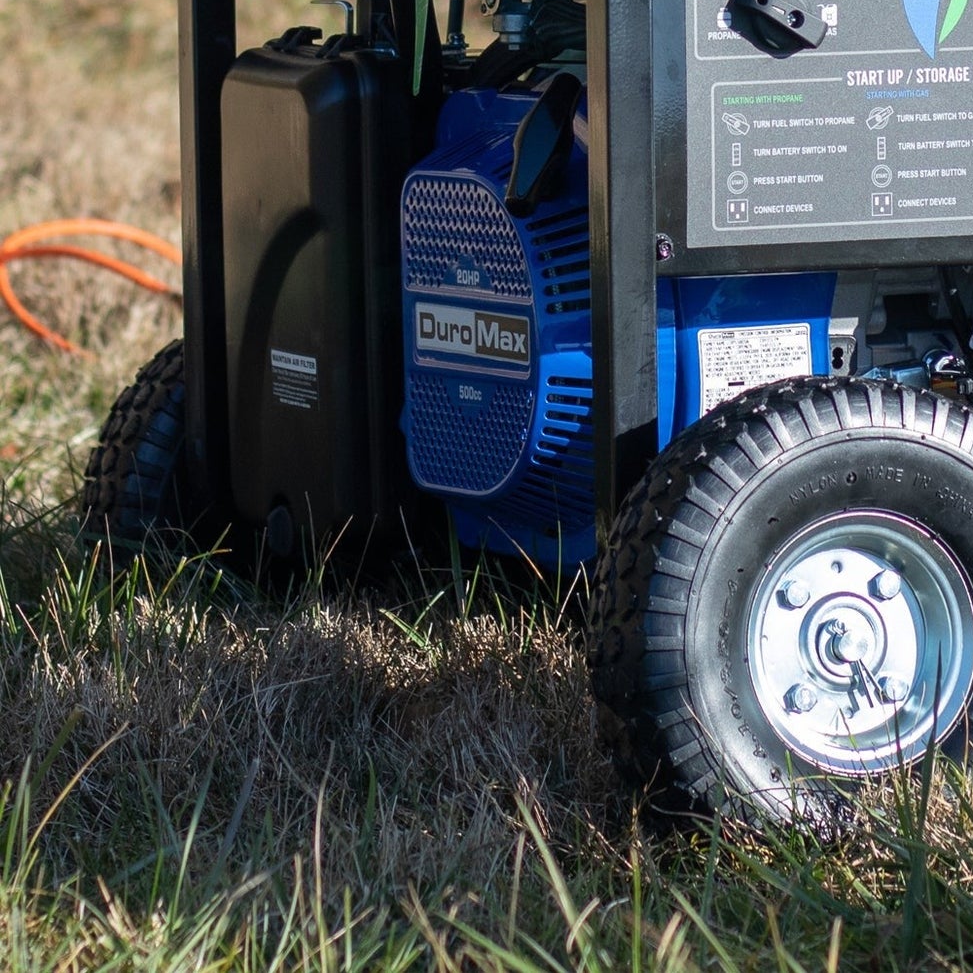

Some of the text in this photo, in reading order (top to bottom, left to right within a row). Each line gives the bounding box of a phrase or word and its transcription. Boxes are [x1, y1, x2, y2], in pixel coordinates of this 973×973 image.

[708, 31, 741, 40] PROPANE
[847, 70, 884, 86] START
[888, 69, 904, 85] UP
[916, 66, 969, 83] STORAGE
[723, 94, 804, 105] STARTING WITH PROPANE
[753, 116, 855, 128] TURN FUEL SWITCH TO PROPANE
[753, 145, 847, 157] TURN BATTERY SWITCH TO ON
[754, 174, 824, 185] PRESS START BUTTON
[754, 204, 813, 214] CONNECT DEVICES
[456, 268, 480, 285] 20HP
[419, 311, 527, 354] Duro Max
[459, 385, 482, 401] 500cc
[789, 473, 837, 505] NYLON
[865, 465, 904, 483] MADE
[912, 472, 932, 489] IN
